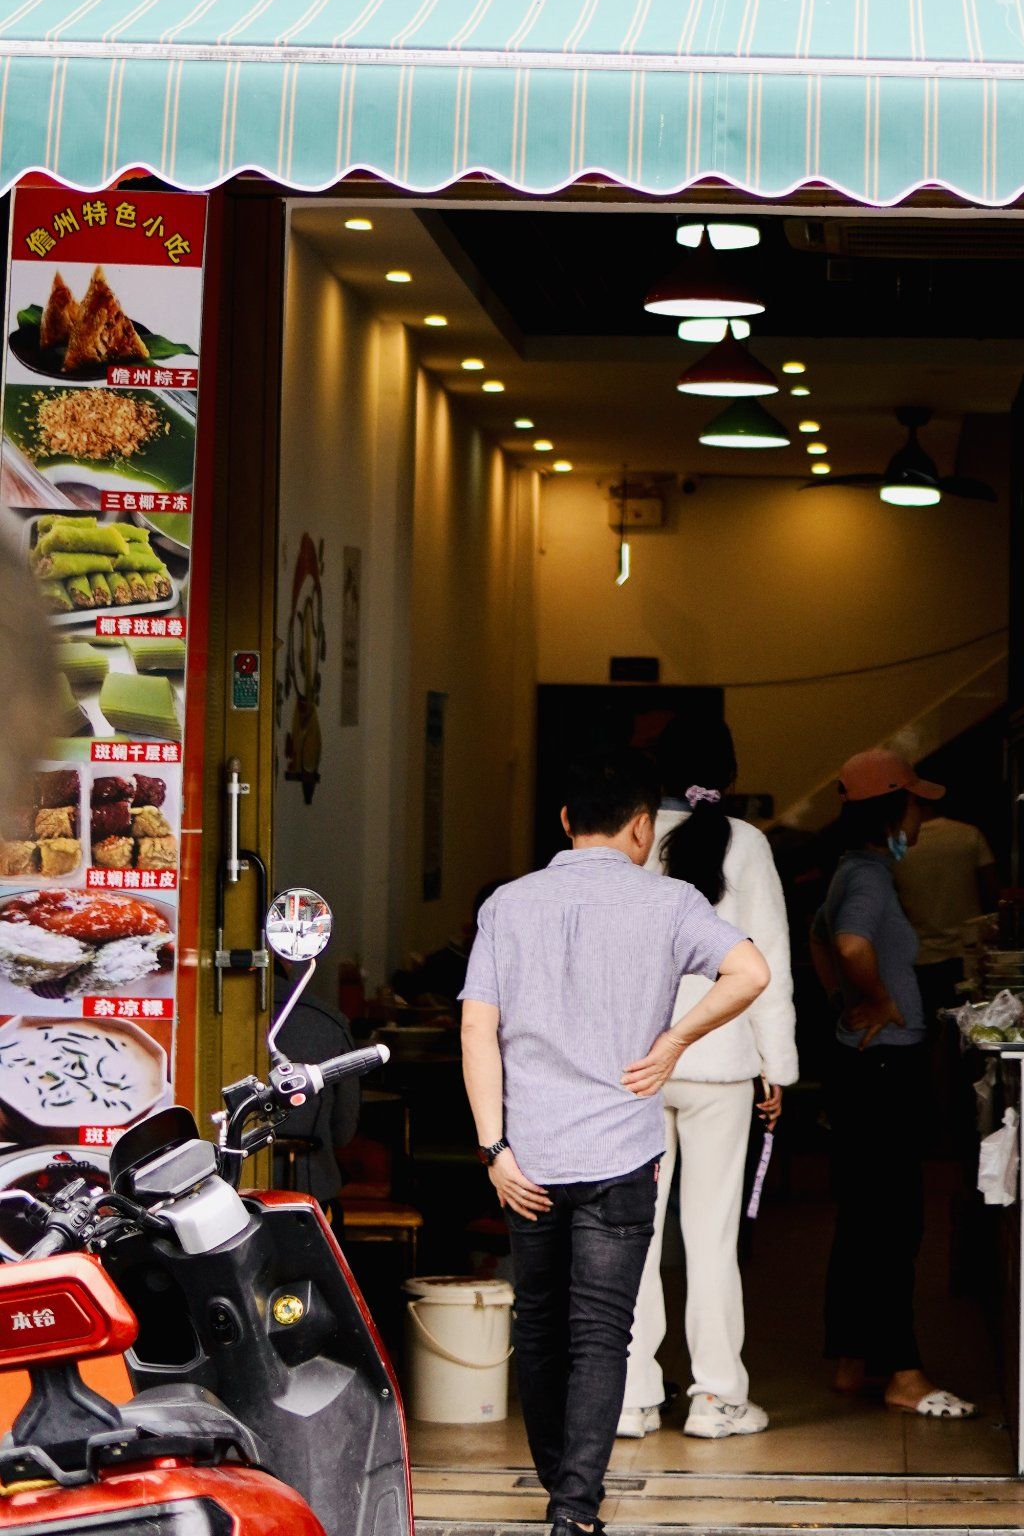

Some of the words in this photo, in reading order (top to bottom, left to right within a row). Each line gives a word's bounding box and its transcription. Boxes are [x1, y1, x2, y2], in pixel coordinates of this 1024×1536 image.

[26, 200, 191, 264] 儋州特色小吃
[111, 367, 195, 386] 儋州粽子
[105, 492, 189, 512] 三色椰子冻
